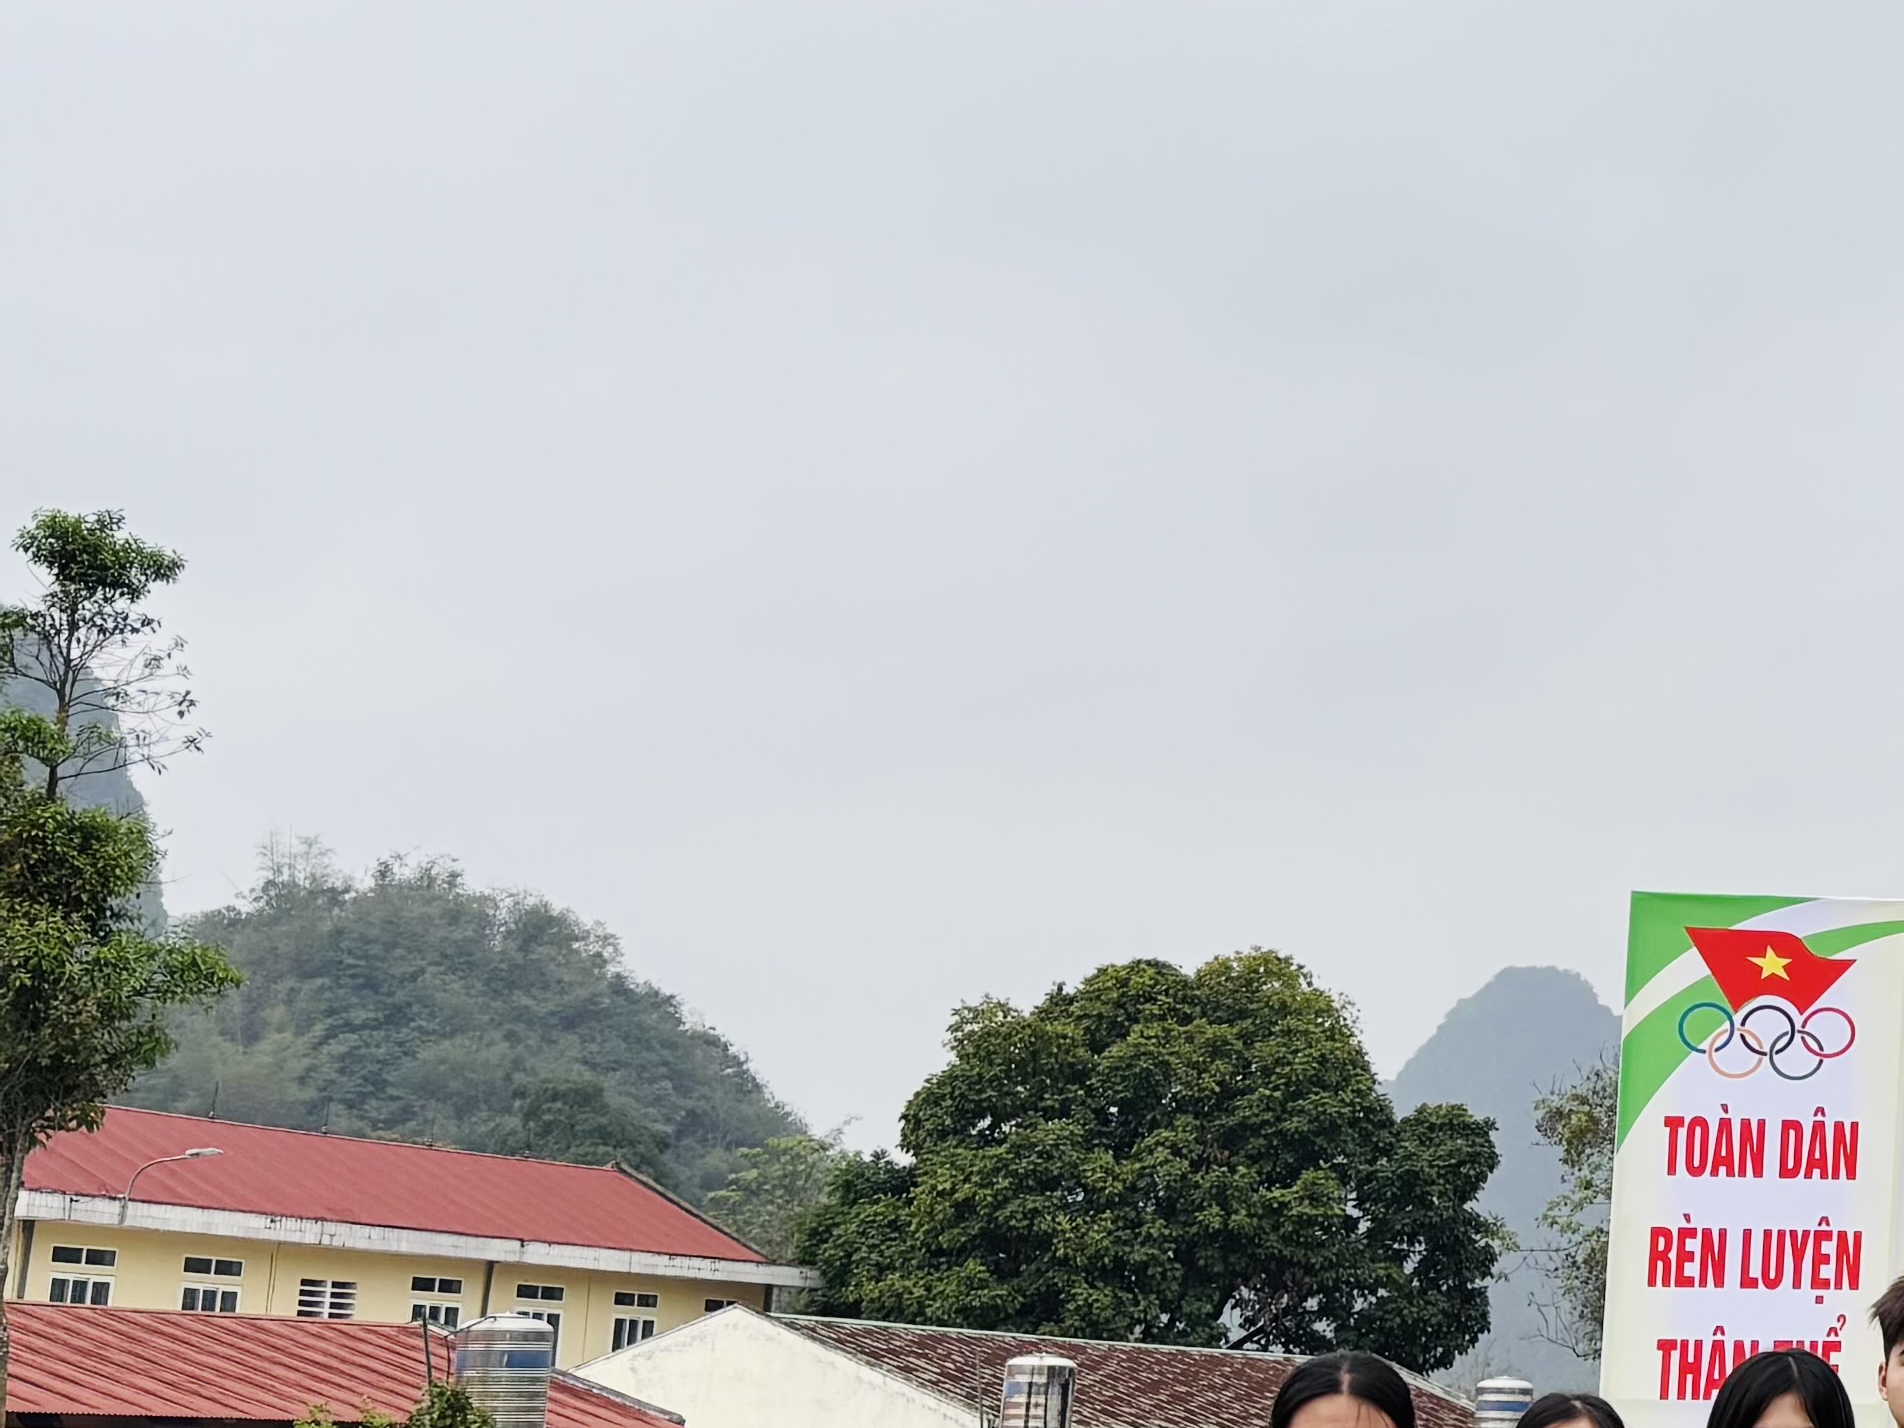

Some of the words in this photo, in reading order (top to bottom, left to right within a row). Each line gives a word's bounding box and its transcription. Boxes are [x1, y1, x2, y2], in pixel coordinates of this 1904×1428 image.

[1664, 1104, 1767, 1179] TOÀN
[1779, 1107, 1860, 1181] DÂN
[1647, 1213, 1728, 1289] RÈN
[1739, 1217, 1863, 1304] LUYỆN
